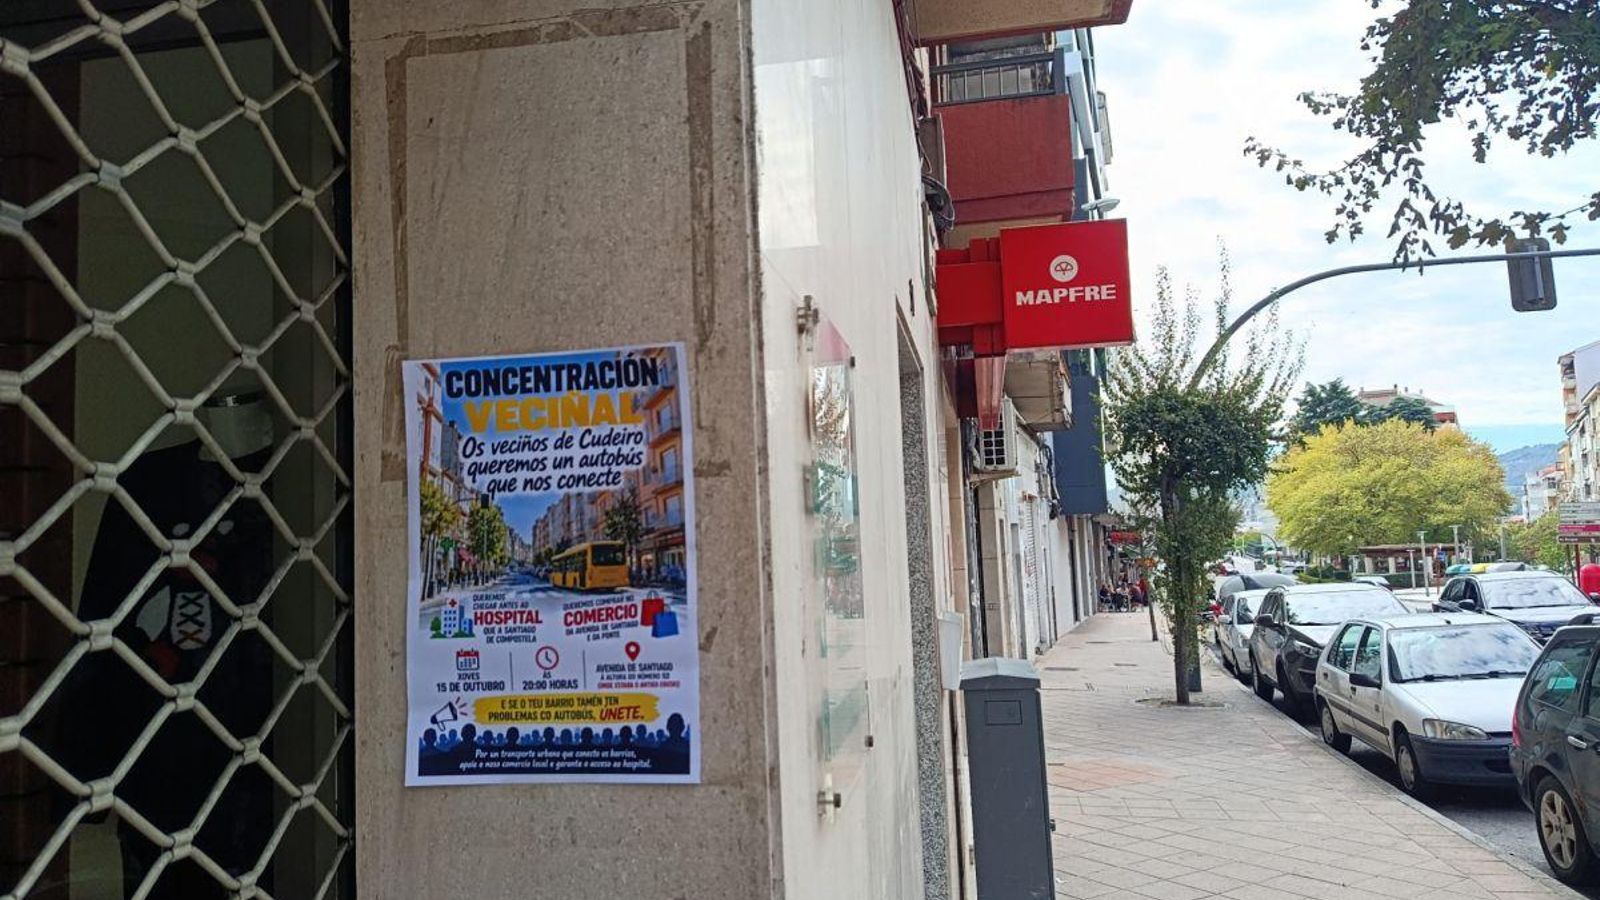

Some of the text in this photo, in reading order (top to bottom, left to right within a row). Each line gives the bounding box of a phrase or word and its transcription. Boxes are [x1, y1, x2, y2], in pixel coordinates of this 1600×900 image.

[1016, 284, 1116, 306] MAPFRE
[445, 352, 659, 398] CONCENTRACIÓN
[464, 390, 643, 433] VECIÑAL
[462, 428, 643, 458] Os veciños de Cudeiro
[467, 447, 643, 483] queremos un autobús
[487, 468, 622, 499] que nos conecte
[472, 594, 506, 602] QUEREMOS
[474, 610, 542, 626] HOSPITAL
[564, 604, 638, 626] COMERCIO
[484, 626, 536, 635] QUE A SANTIAGO
[576, 626, 600, 634] AVENIDA
[611, 620, 638, 630] SANTIAGO
[486, 634, 536, 644] DE COMPOSTELA
[596, 662, 674, 672] AVENIDA DE SANTIAGO
[457, 672, 480, 680] XOVES
[436, 680, 505, 692] 15 DE OUTUBRO
[522, 680, 578, 690] 20:00 HORAS
[501, 700, 506, 709] E
[508, 700, 518, 709] SE
[520, 699, 526, 708] O
[528, 698, 544, 708] TEU
[545, 698, 574, 708] BARRIO
[576, 696, 602, 706] TAMÉN
[488, 711, 538, 721] PROBLEMAS
[540, 710, 552, 720] CO
[475, 749, 488, 758] Por
[500, 750, 536, 760] transporte
[537, 748, 560, 758] urbano
[562, 751, 574, 760] que
